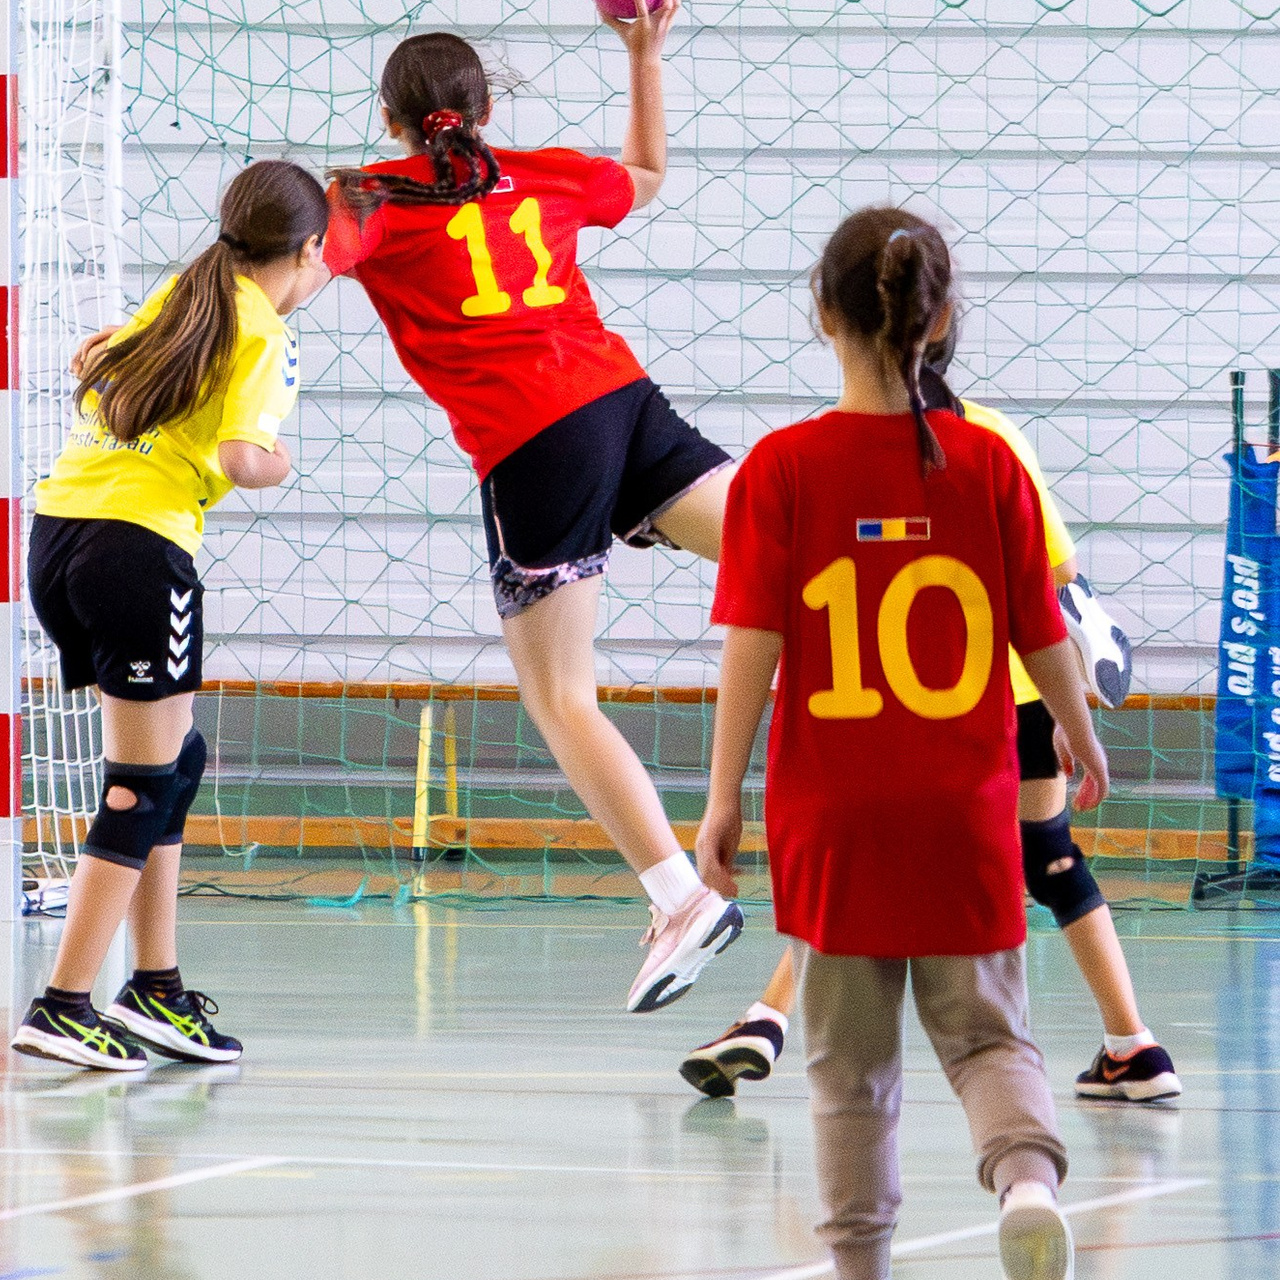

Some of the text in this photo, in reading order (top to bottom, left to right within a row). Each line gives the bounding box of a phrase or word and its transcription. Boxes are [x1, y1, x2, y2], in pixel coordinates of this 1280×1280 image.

[446, 197, 566, 317] 11
[801, 554, 994, 720] 10
[1222, 554, 1267, 697] pro's pro
